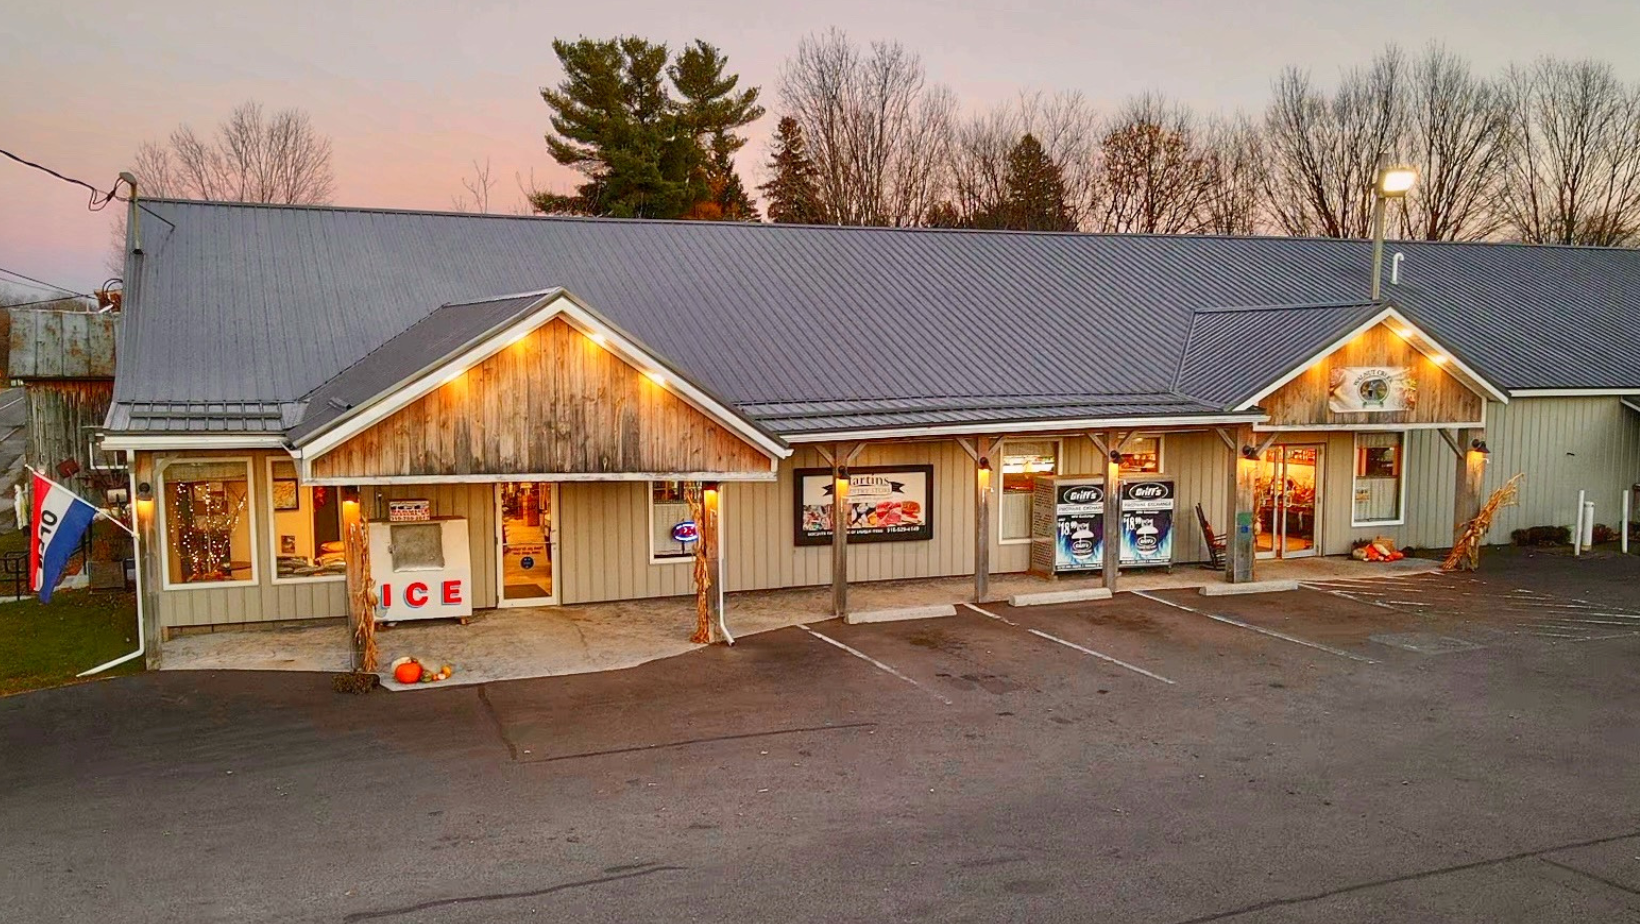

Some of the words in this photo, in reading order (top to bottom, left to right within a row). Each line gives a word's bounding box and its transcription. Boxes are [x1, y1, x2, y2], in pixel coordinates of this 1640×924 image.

[849, 475, 889, 486] artins
[1070, 489, 1097, 501] Griff's
[1135, 486, 1162, 496] Griff's
[381, 580, 462, 608] ICE
